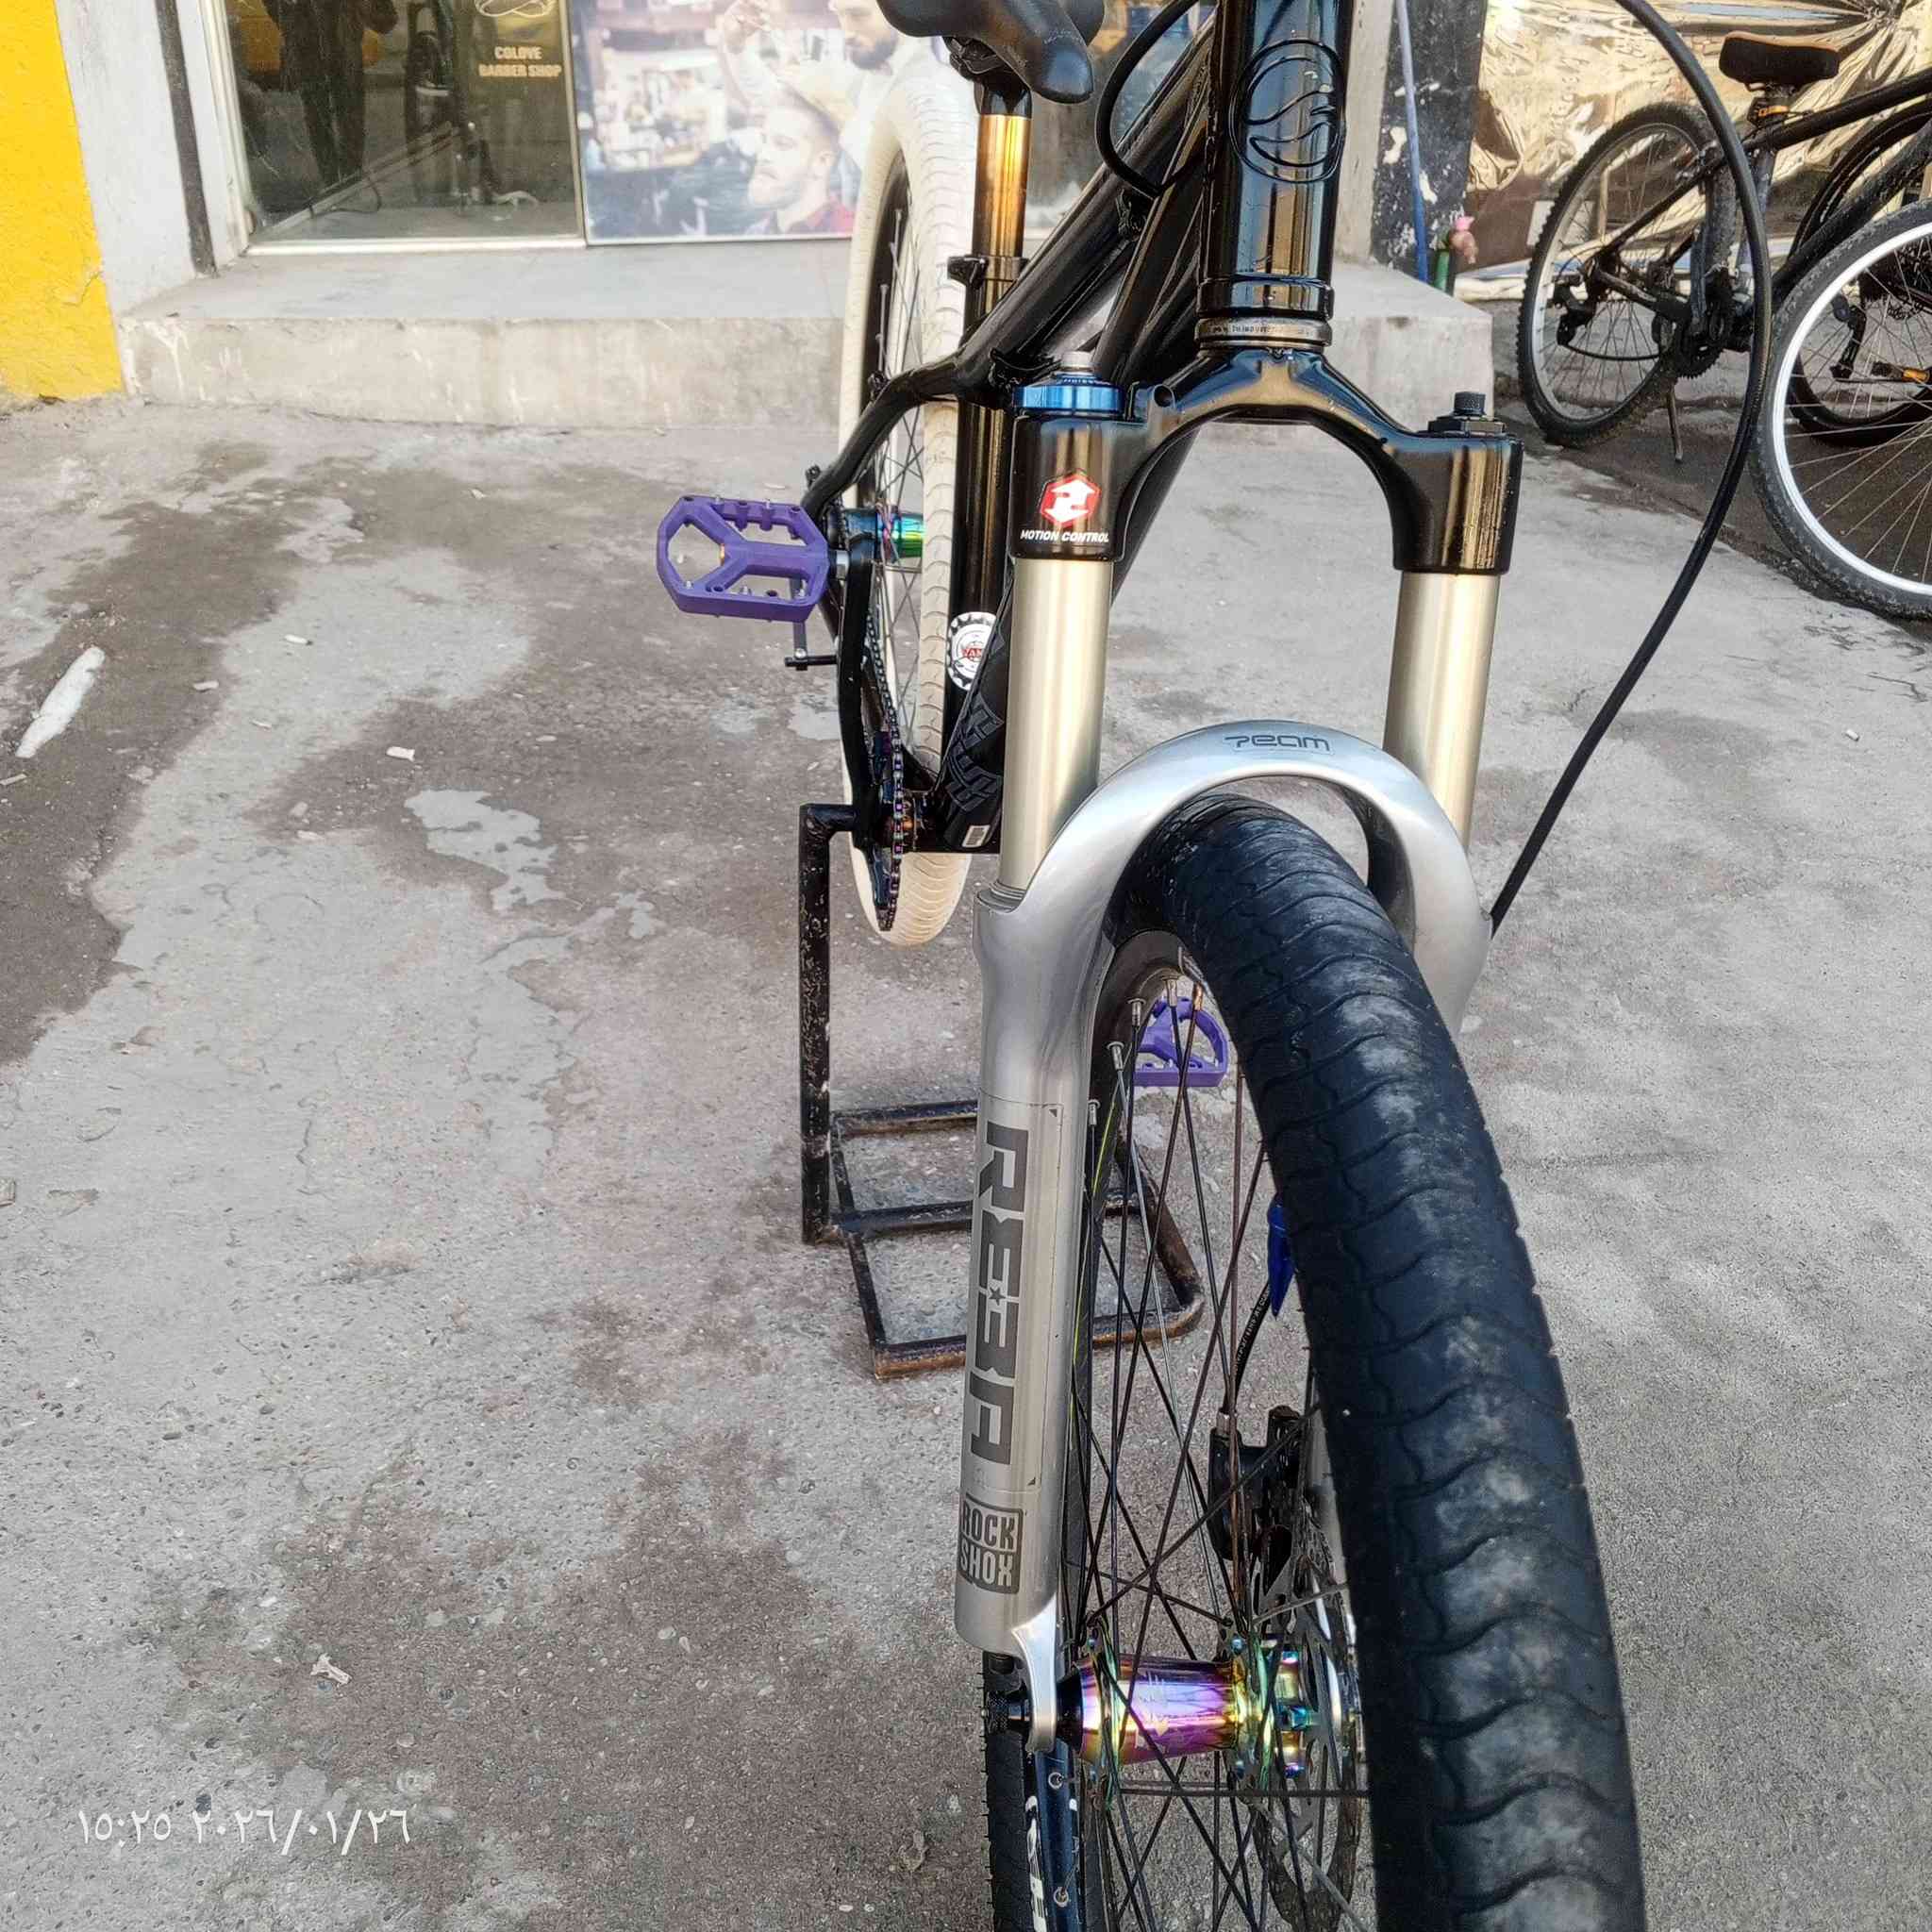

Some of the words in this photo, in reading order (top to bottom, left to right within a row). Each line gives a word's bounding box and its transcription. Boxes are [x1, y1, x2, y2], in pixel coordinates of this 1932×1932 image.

[527, 64, 562, 77] SHOP
[1020, 529, 1059, 541] MOTION
[1061, 530, 1109, 543] CONTROL
[969, 1121, 1030, 1466] REBA
[961, 1500, 1016, 1551] ROCK
[960, 1540, 1014, 1588] SHOX
